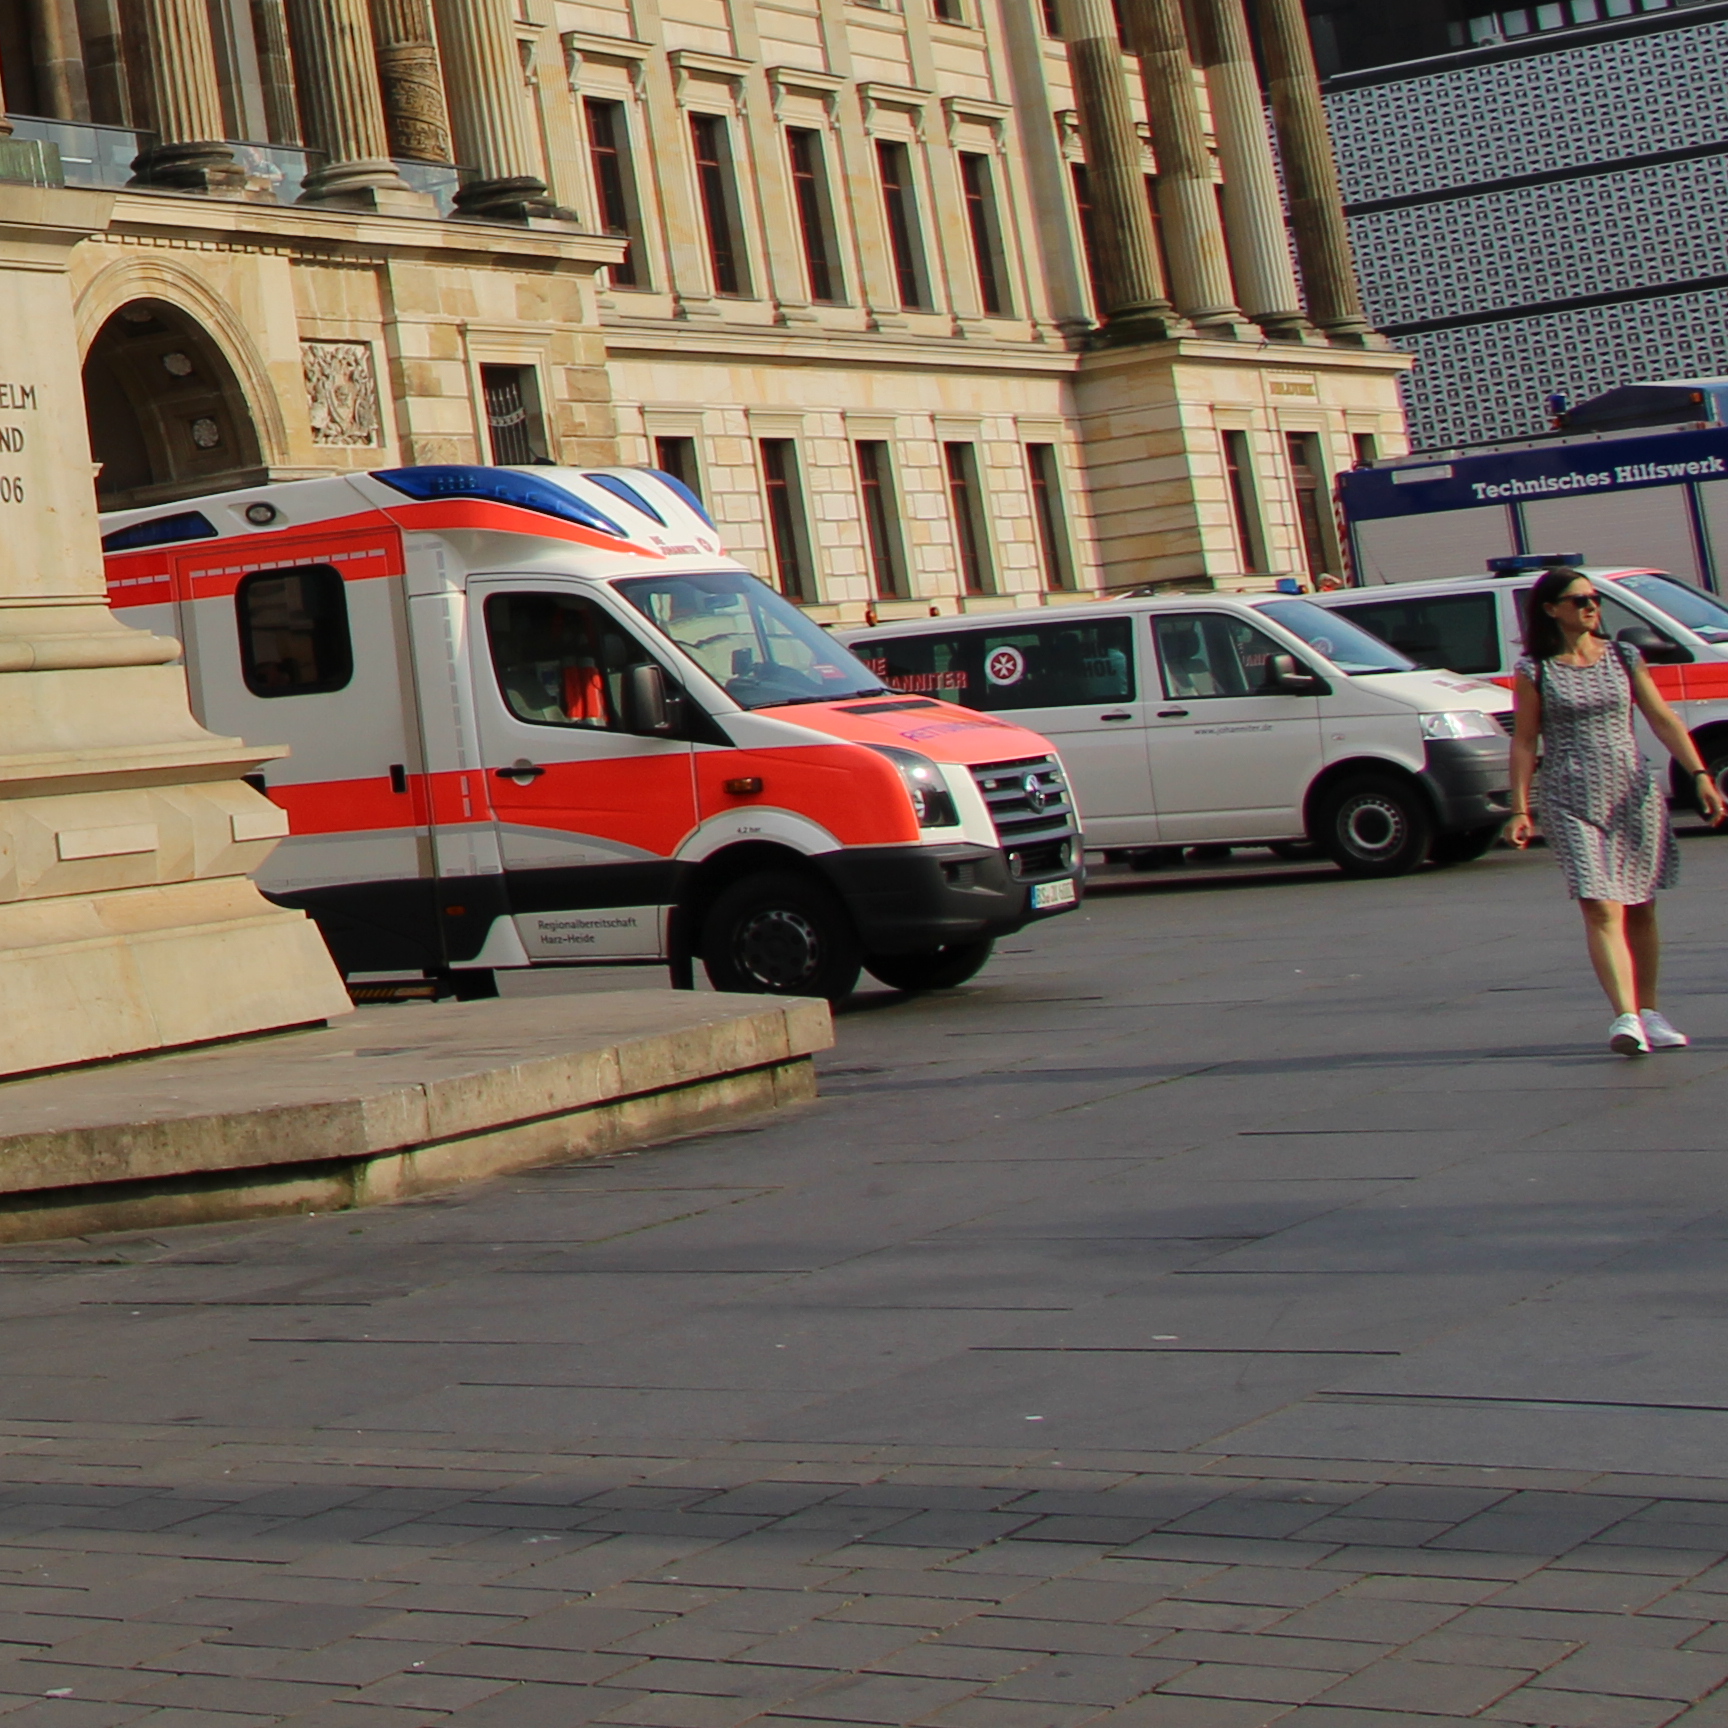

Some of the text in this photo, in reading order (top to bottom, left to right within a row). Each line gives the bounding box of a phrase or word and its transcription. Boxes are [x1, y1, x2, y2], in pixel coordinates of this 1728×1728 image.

[1472, 455, 1724, 500] Technisches Hilfswerk
[537, 917, 637, 932] Regionalbereitschaft
[540, 934, 595, 944] Harz-Heide
